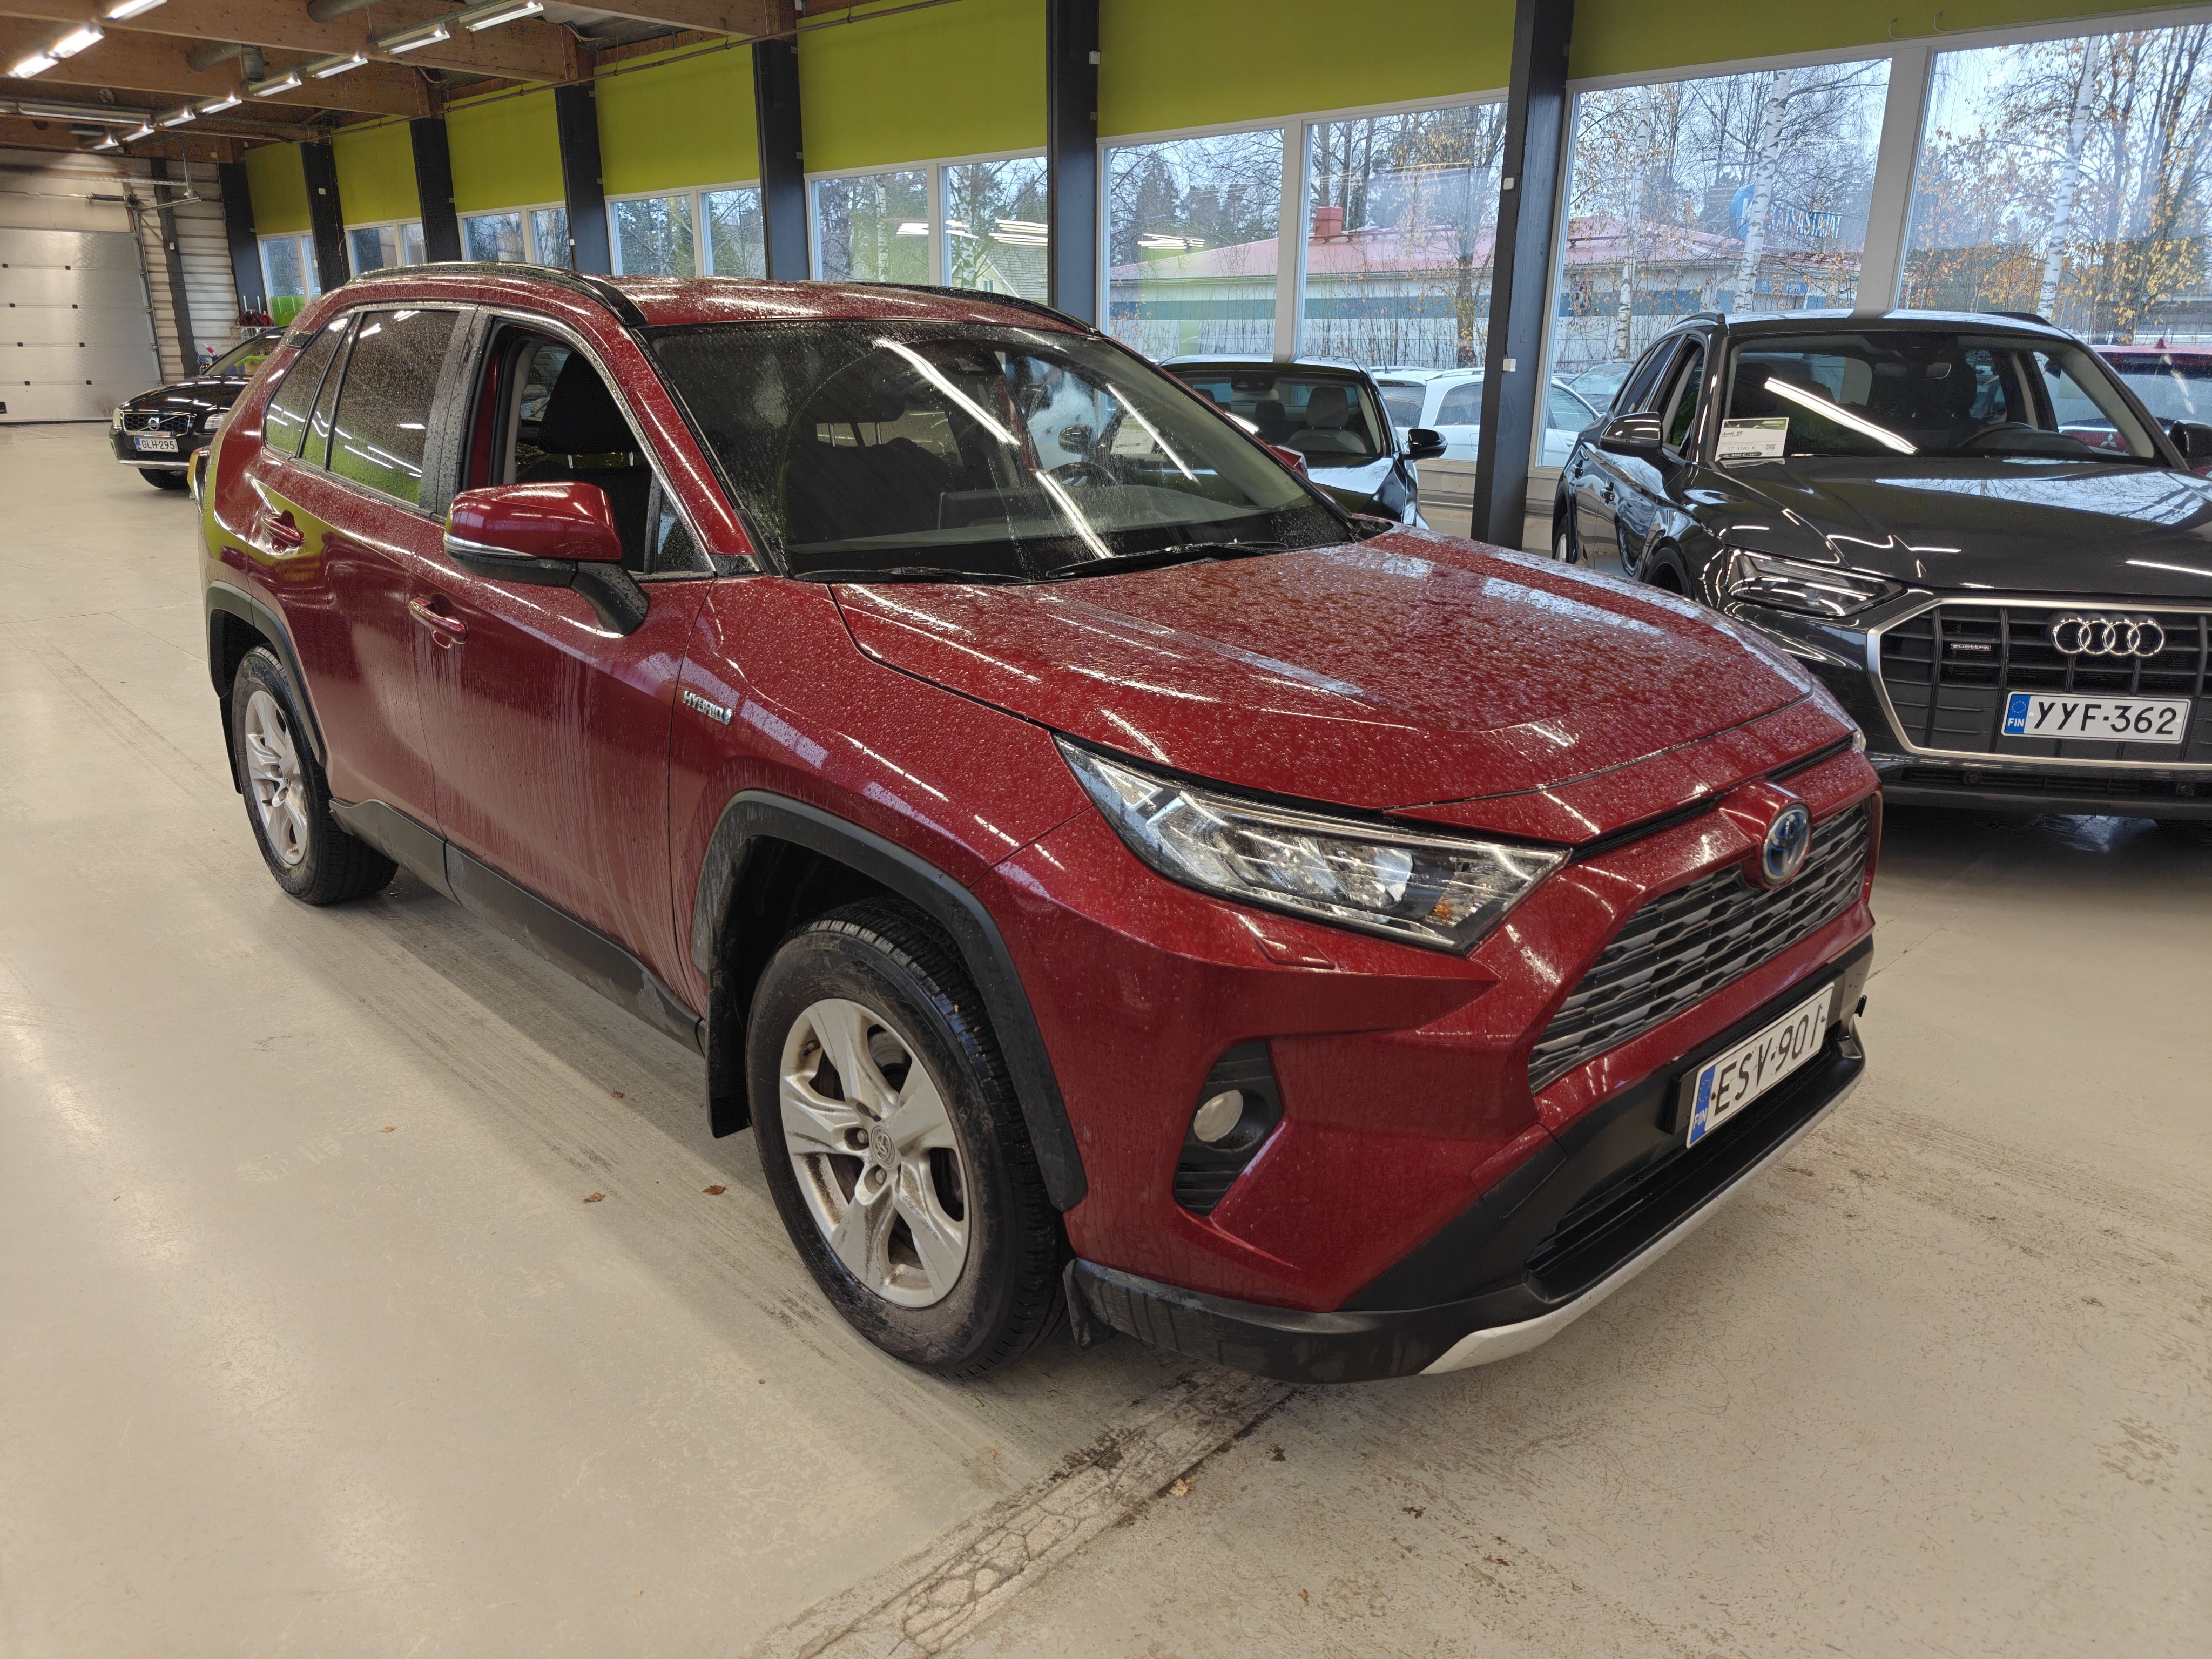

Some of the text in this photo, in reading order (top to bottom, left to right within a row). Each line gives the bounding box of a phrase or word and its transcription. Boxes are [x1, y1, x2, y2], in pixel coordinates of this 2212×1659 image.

[141, 440, 175, 449] GLH-295
[682, 691, 724, 721] HYBRID
[2007, 701, 2177, 735] FIN YYF-362
[1693, 1003, 1822, 1129] FIN ESV-901
